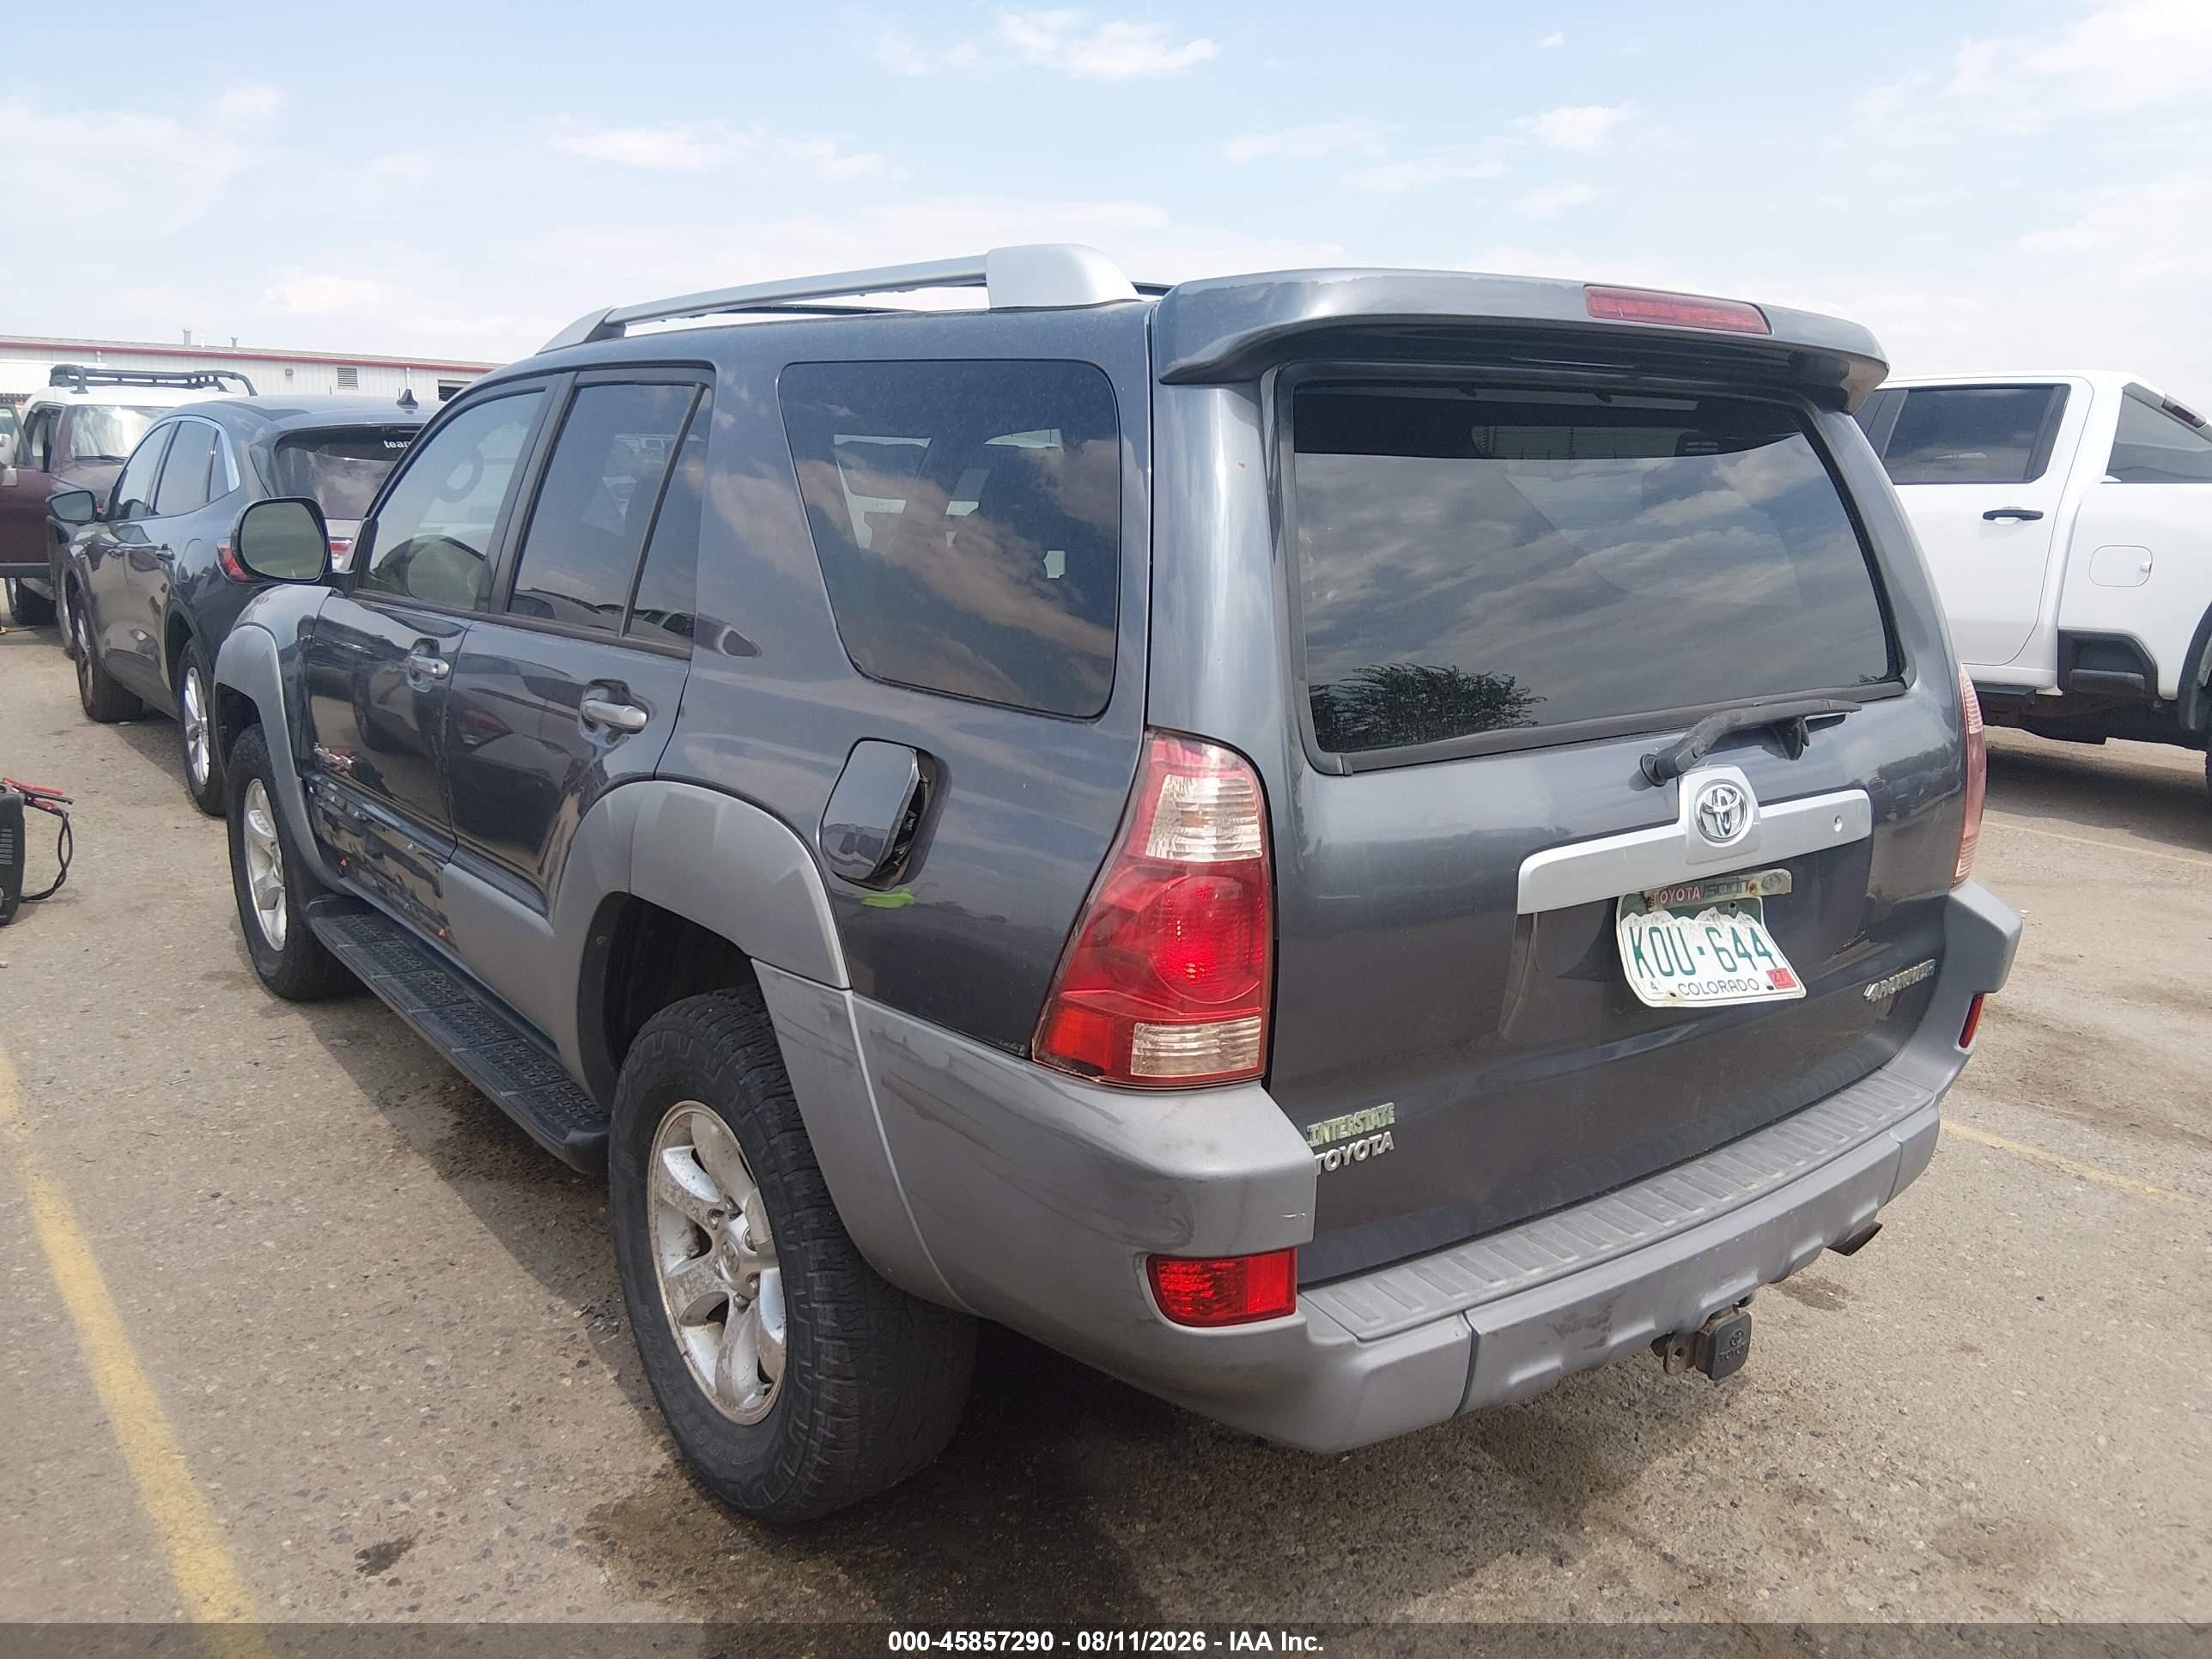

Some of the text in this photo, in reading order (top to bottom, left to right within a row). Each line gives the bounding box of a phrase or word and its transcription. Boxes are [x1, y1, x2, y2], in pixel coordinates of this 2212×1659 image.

[1677, 977, 1760, 997] COLORADO
[1306, 1103, 1395, 1147] INTERSTATE
[1314, 1131, 1395, 1176] TOYOTA
